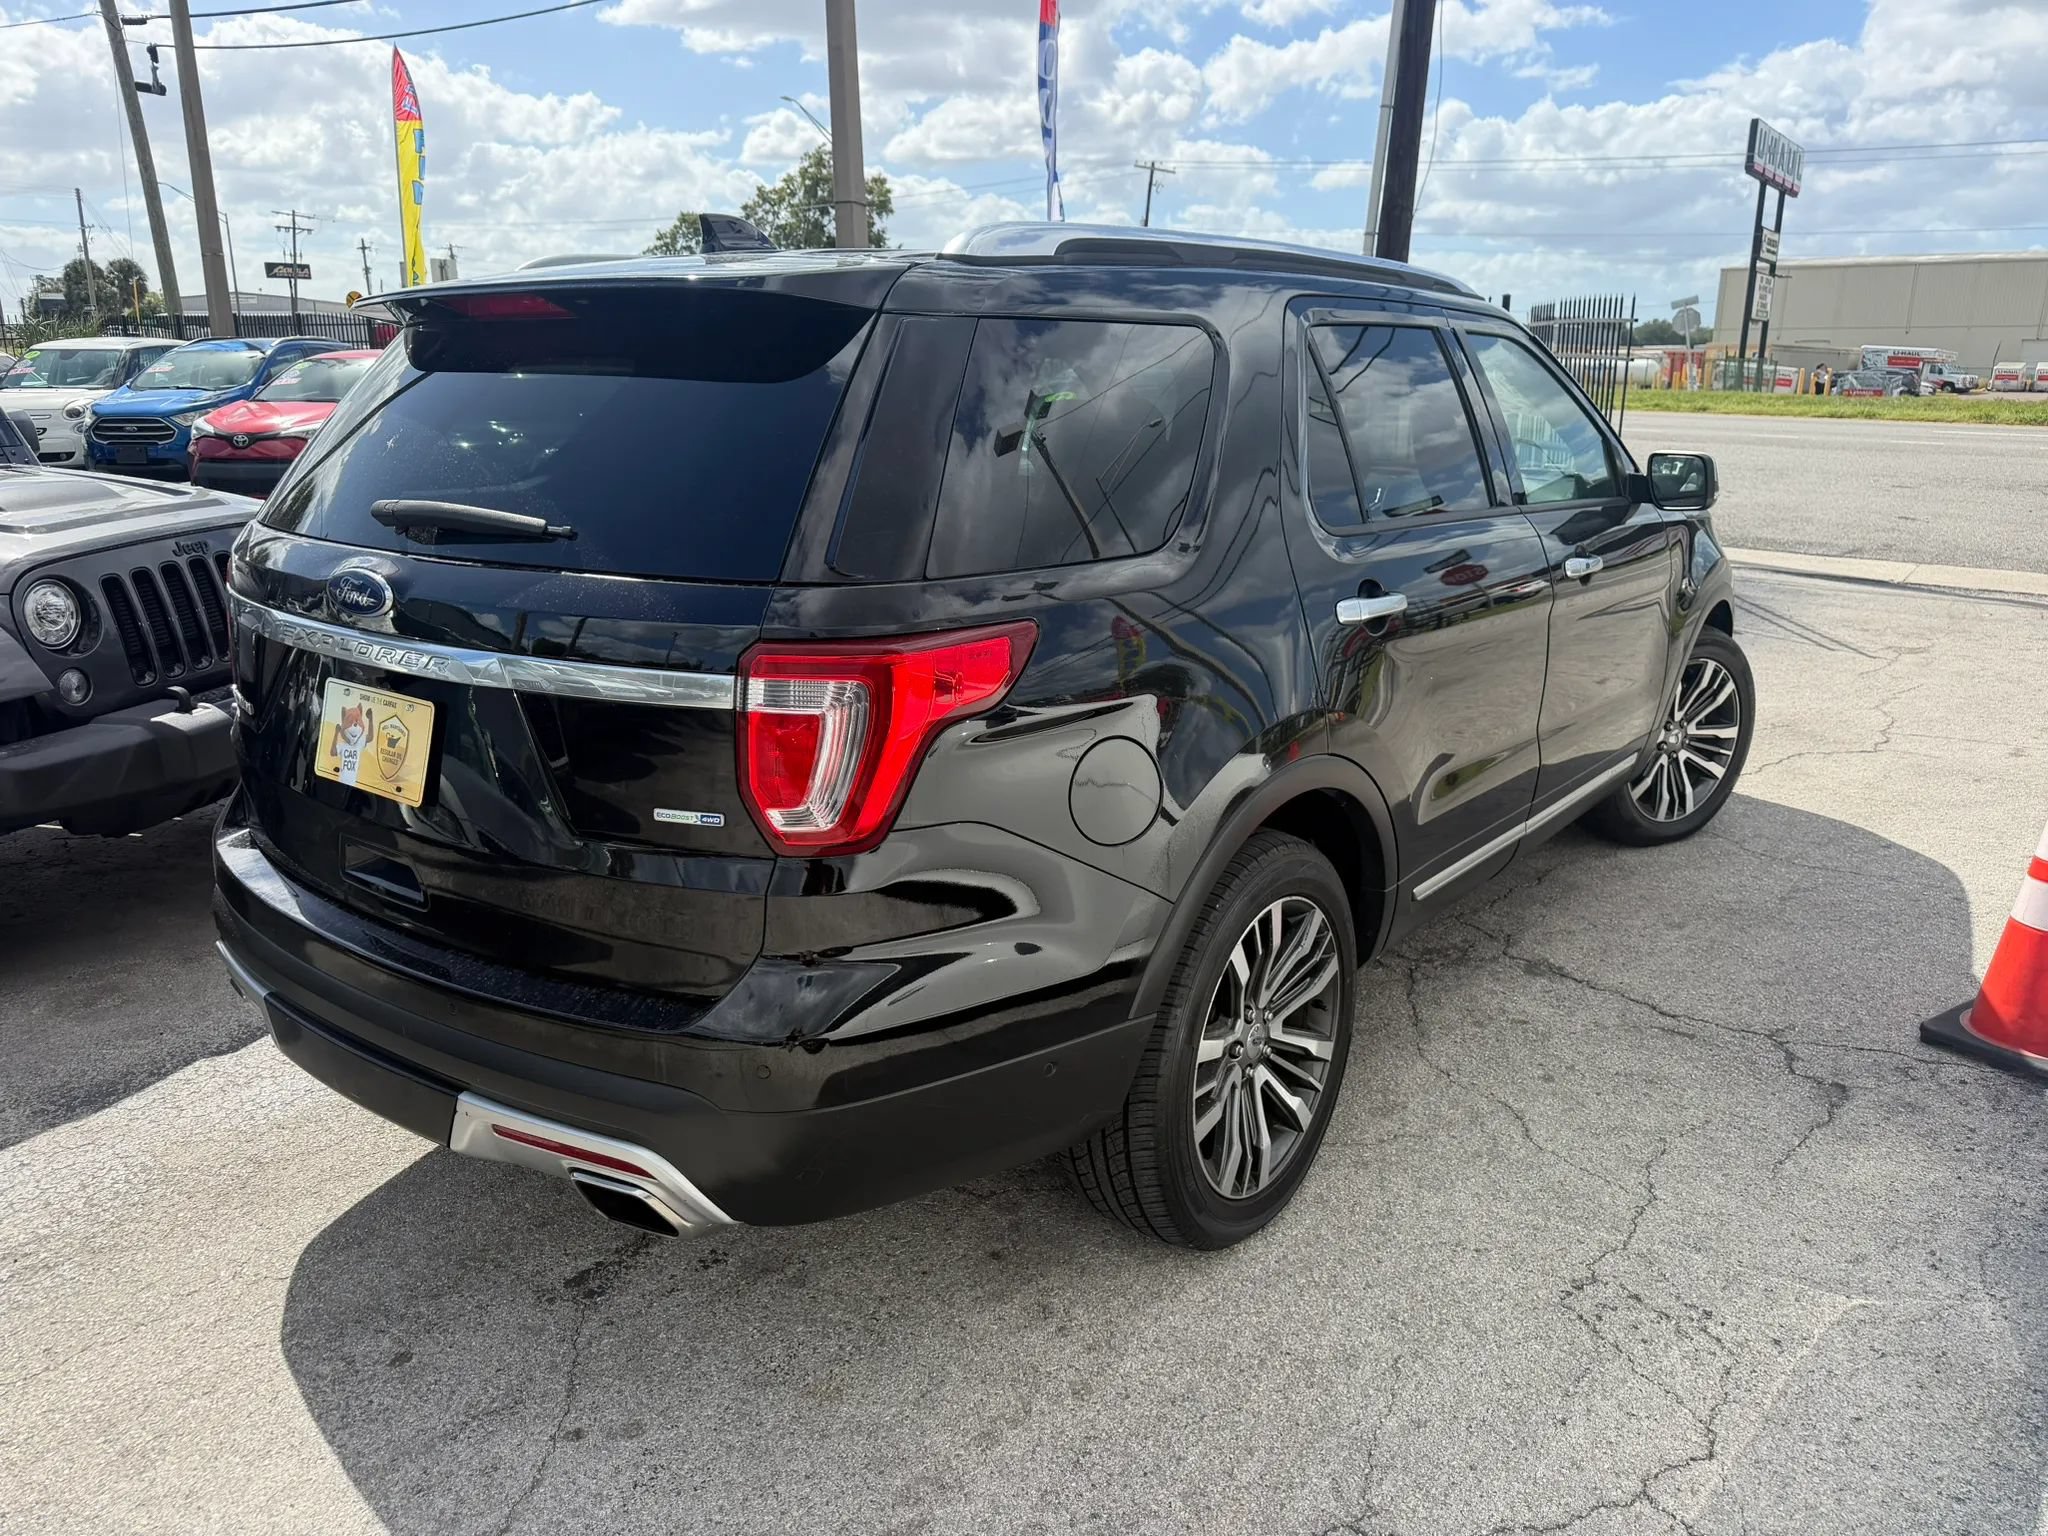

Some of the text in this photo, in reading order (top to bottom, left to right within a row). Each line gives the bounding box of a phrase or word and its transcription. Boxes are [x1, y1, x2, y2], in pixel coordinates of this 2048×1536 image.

[172, 541, 208, 557] Jeep
[336, 575, 379, 607] Ford
[281, 619, 451, 675] EXPLORER
[343, 749, 357, 760] CAR
[343, 760, 357, 772] FOX
